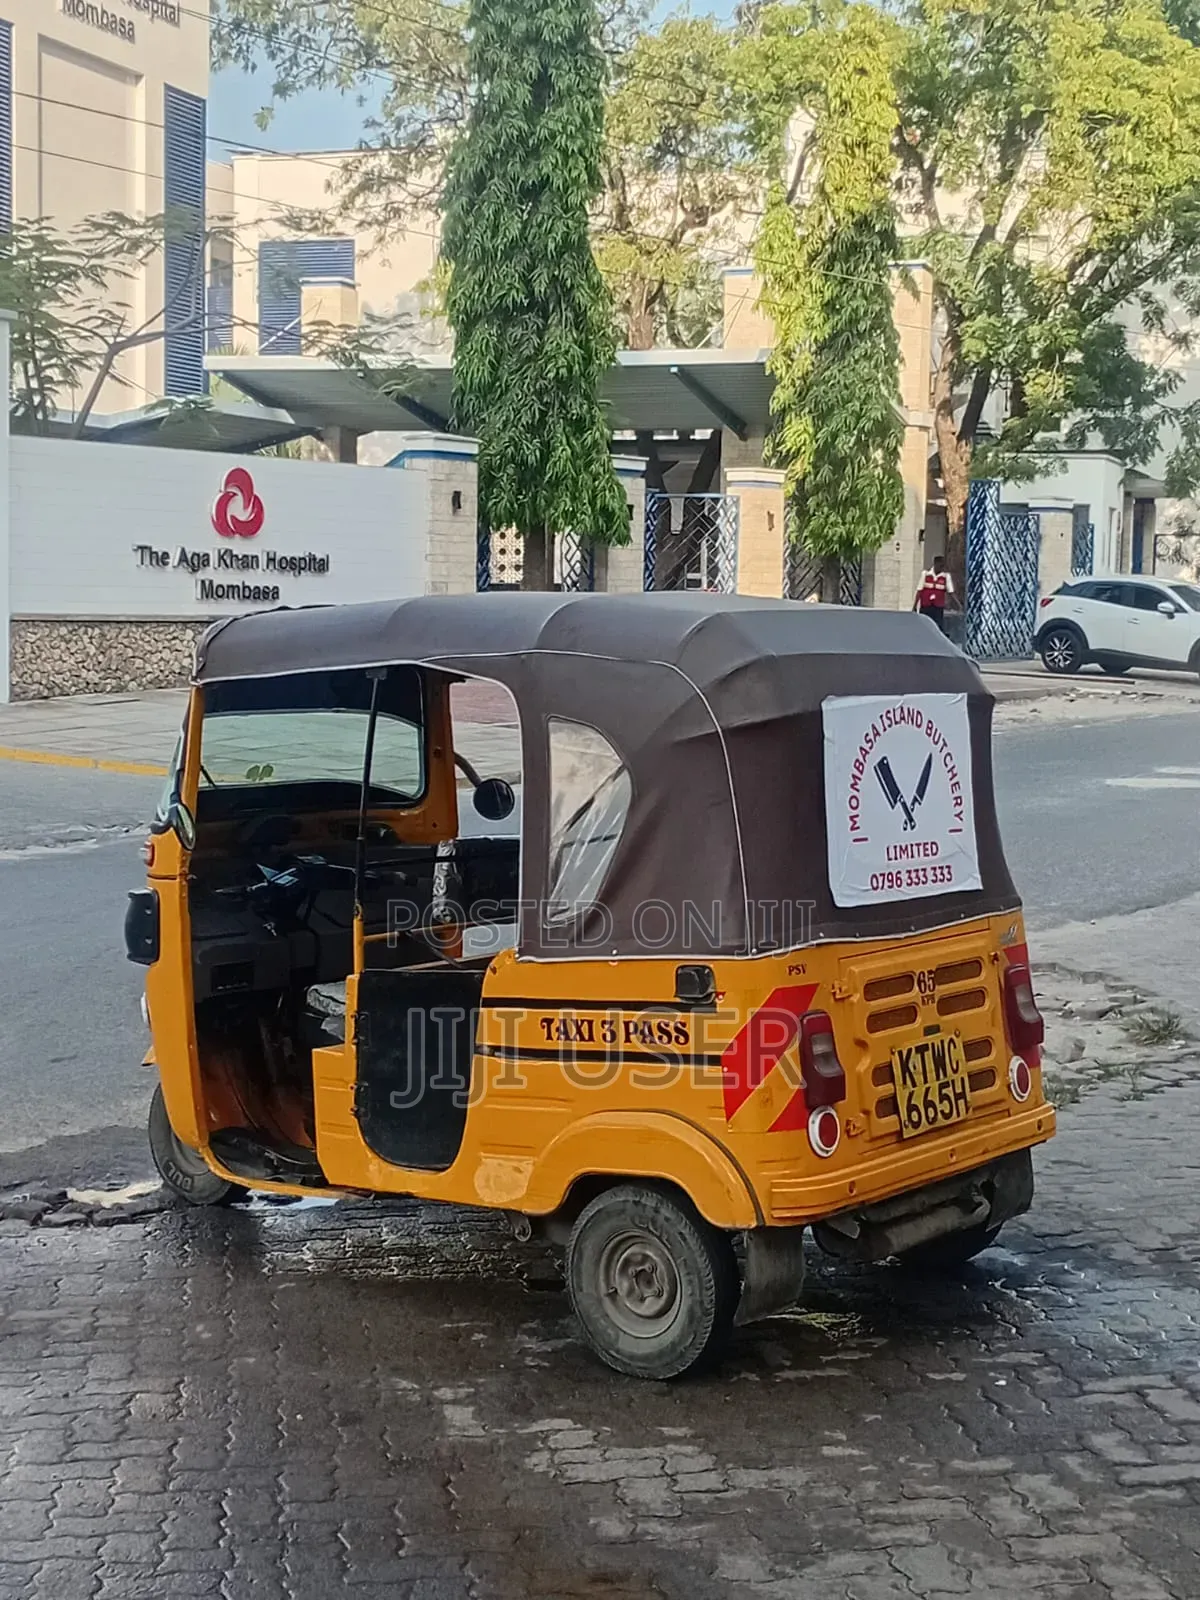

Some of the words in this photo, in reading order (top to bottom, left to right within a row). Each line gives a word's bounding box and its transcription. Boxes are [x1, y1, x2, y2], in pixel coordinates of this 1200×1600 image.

[62, 0, 135, 40] Mombasa
[120, 0, 180, 26] ospital
[136, 545, 170, 568] The
[176, 547, 210, 574] Aga
[216, 548, 260, 570] Khan
[265, 551, 330, 576] Hospital
[199, 579, 280, 601] Mombasa
[848, 723, 881, 832] MOMBASA
[880, 706, 923, 732] ISLAND
[925, 719, 964, 822] BUTCHERY
[886, 841, 940, 861] LIMITED
[870, 870, 903, 891] 0796
[905, 867, 928, 887] 333
[930, 864, 953, 884] 333
[787, 963, 808, 977] PSV
[917, 968, 936, 994] 65
[540, 1017, 596, 1043] TAXI
[601, 1019, 618, 1044] 3
[623, 1018, 690, 1047] PASS
[897, 1037, 960, 1089] KTWC
[906, 1076, 969, 1130] 665H
